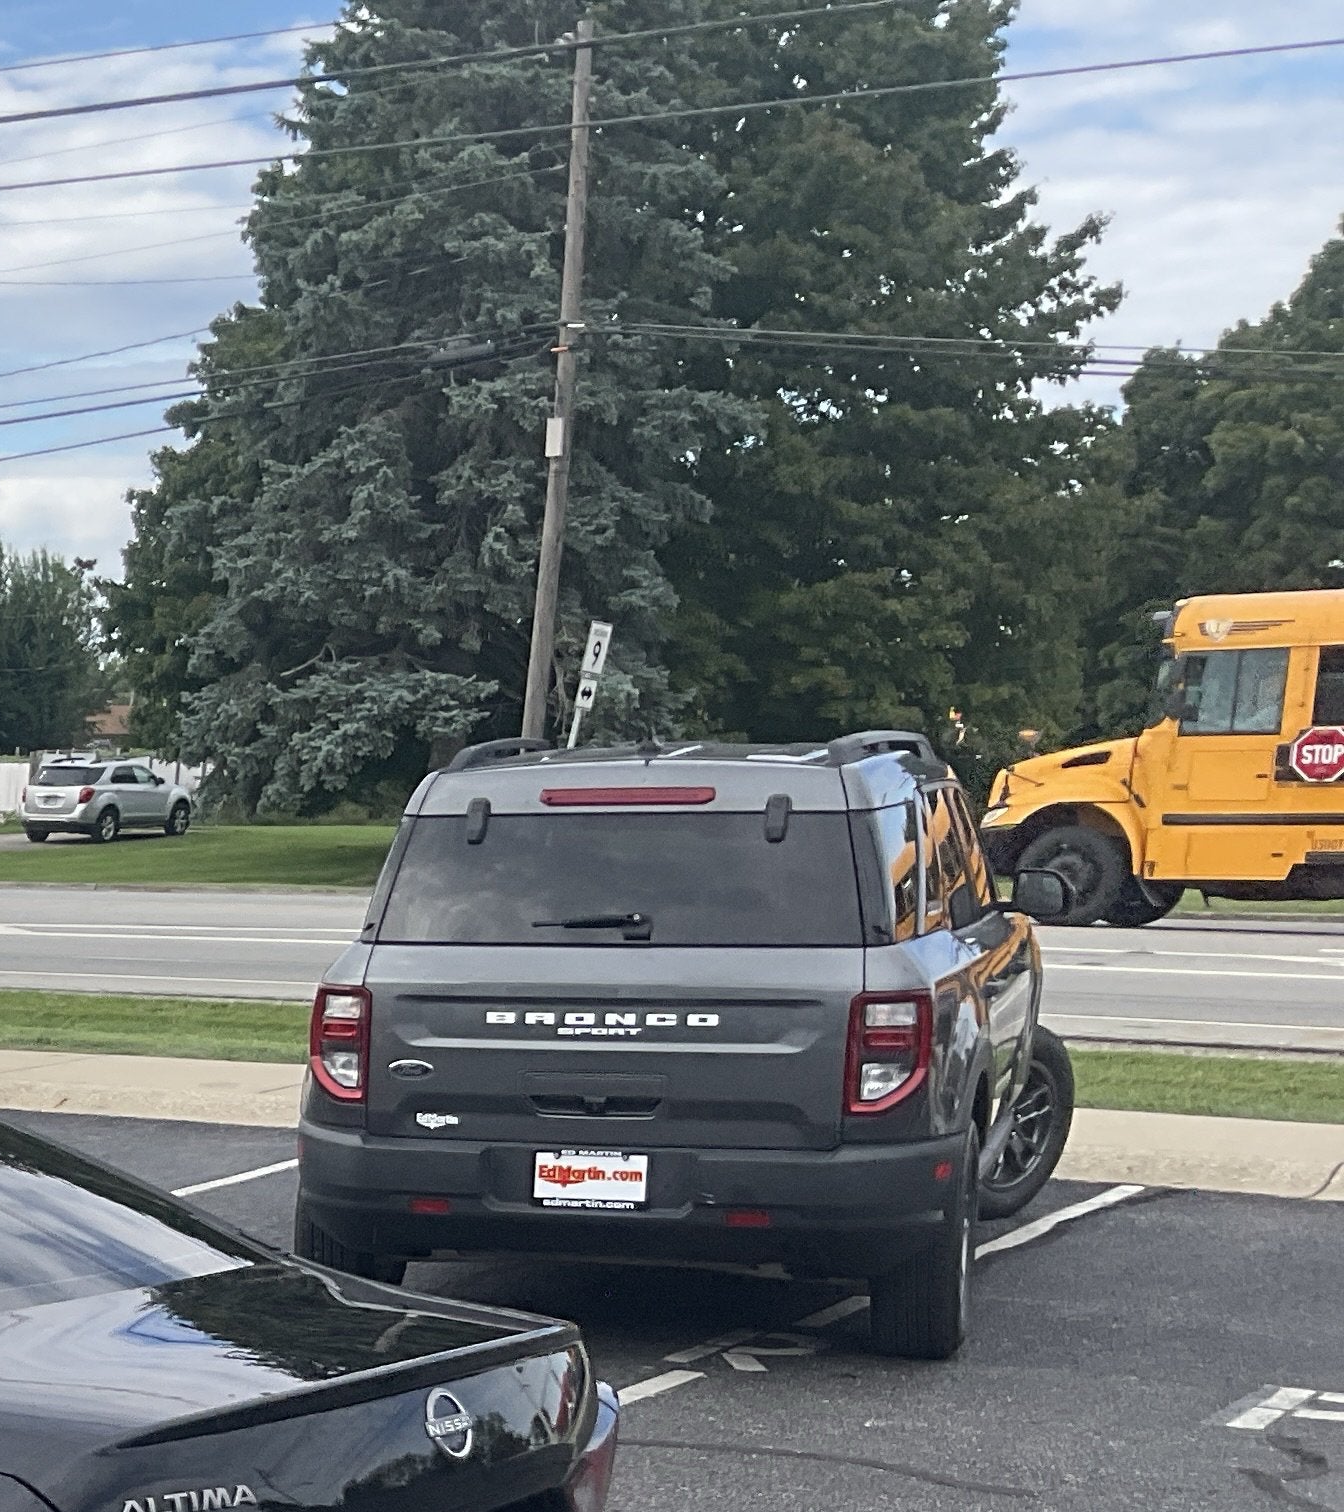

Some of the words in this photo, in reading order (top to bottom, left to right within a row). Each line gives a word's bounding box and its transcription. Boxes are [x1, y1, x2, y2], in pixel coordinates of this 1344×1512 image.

[1300, 744, 1344, 765] STOP
[486, 1011, 719, 1027] BRONCO
[557, 1027, 642, 1035] SPORT
[538, 1165, 643, 1185] EdMartin.com
[542, 1198, 635, 1210] edmartin.com
